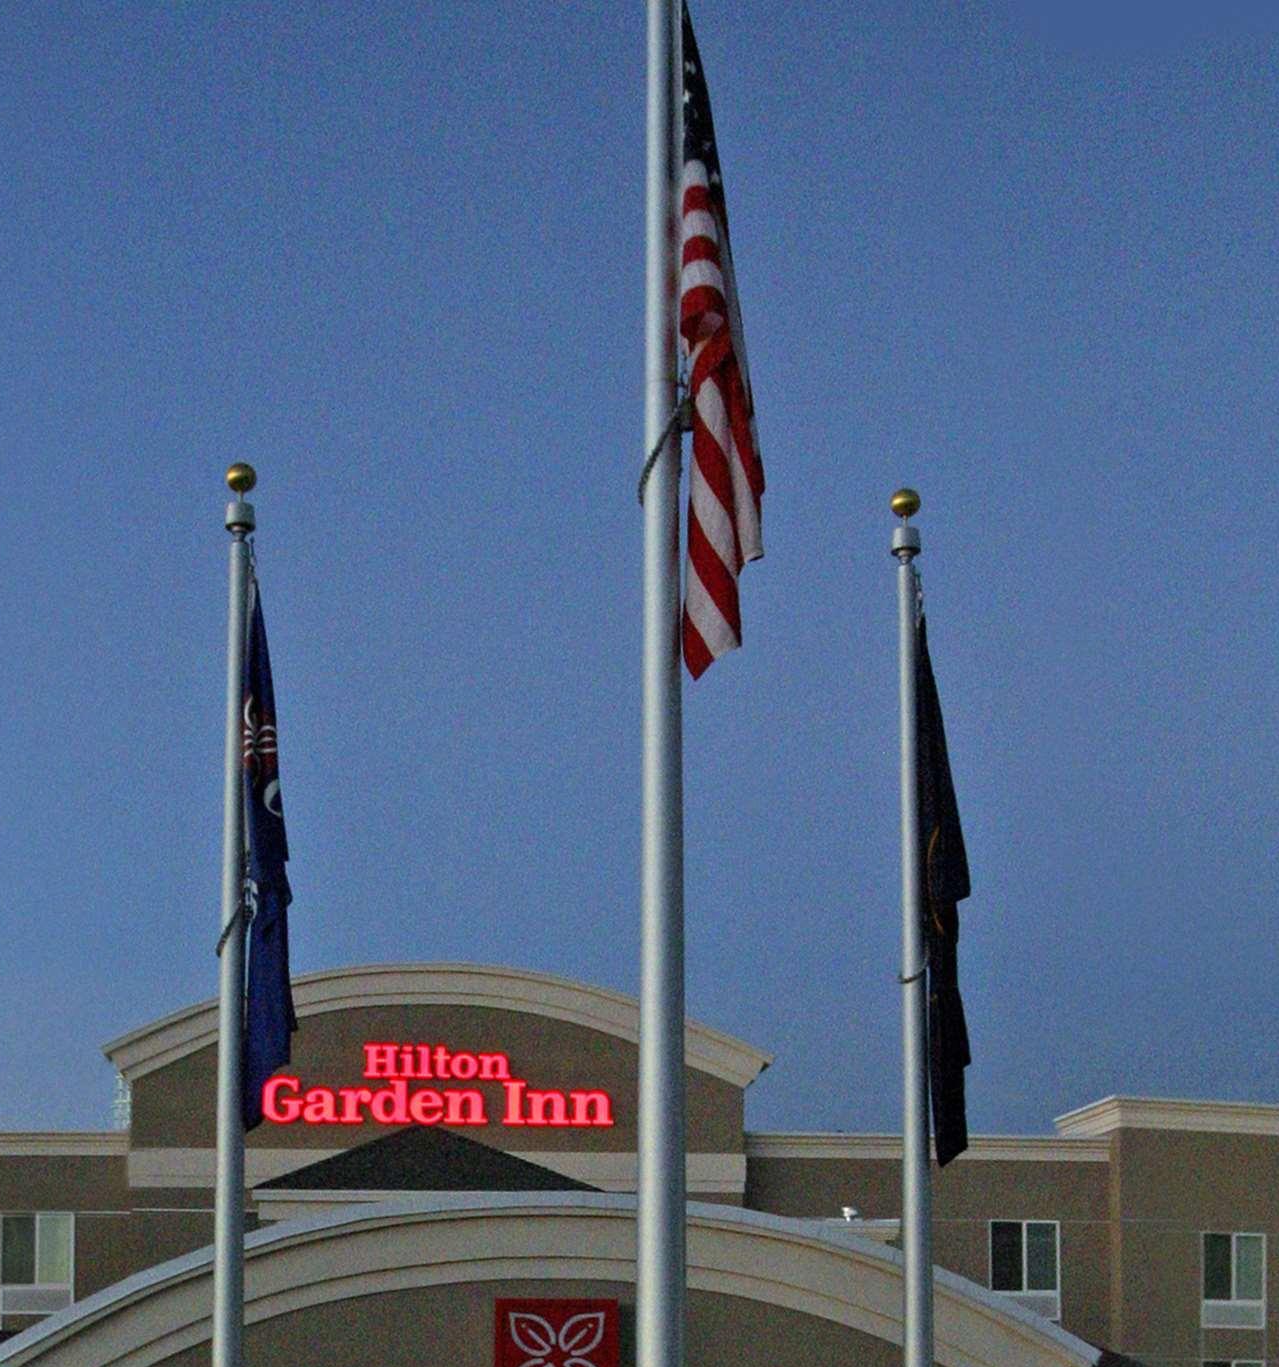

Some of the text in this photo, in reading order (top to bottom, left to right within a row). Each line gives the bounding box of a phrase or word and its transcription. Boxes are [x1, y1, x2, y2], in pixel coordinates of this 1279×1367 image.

[363, 1042, 511, 1080] Hilton
[261, 1075, 614, 1127] Garden Inn
